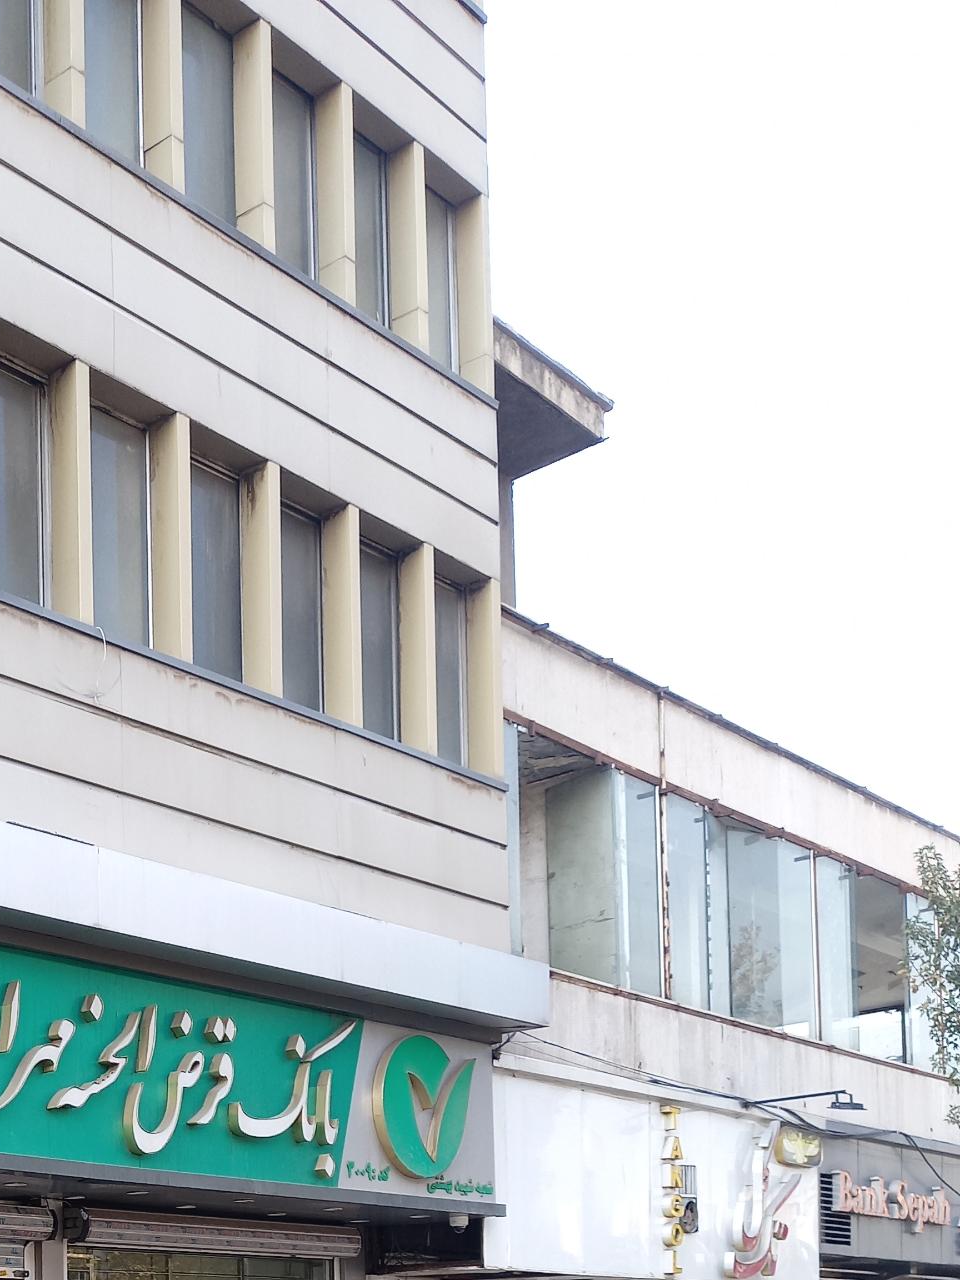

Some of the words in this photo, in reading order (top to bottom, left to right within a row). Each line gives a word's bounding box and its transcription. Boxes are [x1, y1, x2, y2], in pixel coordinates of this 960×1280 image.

[227, 1017, 359, 1178] بانک
[831, 1170, 891, 1219] Bank
[888, 1180, 952, 1234] Sepah
